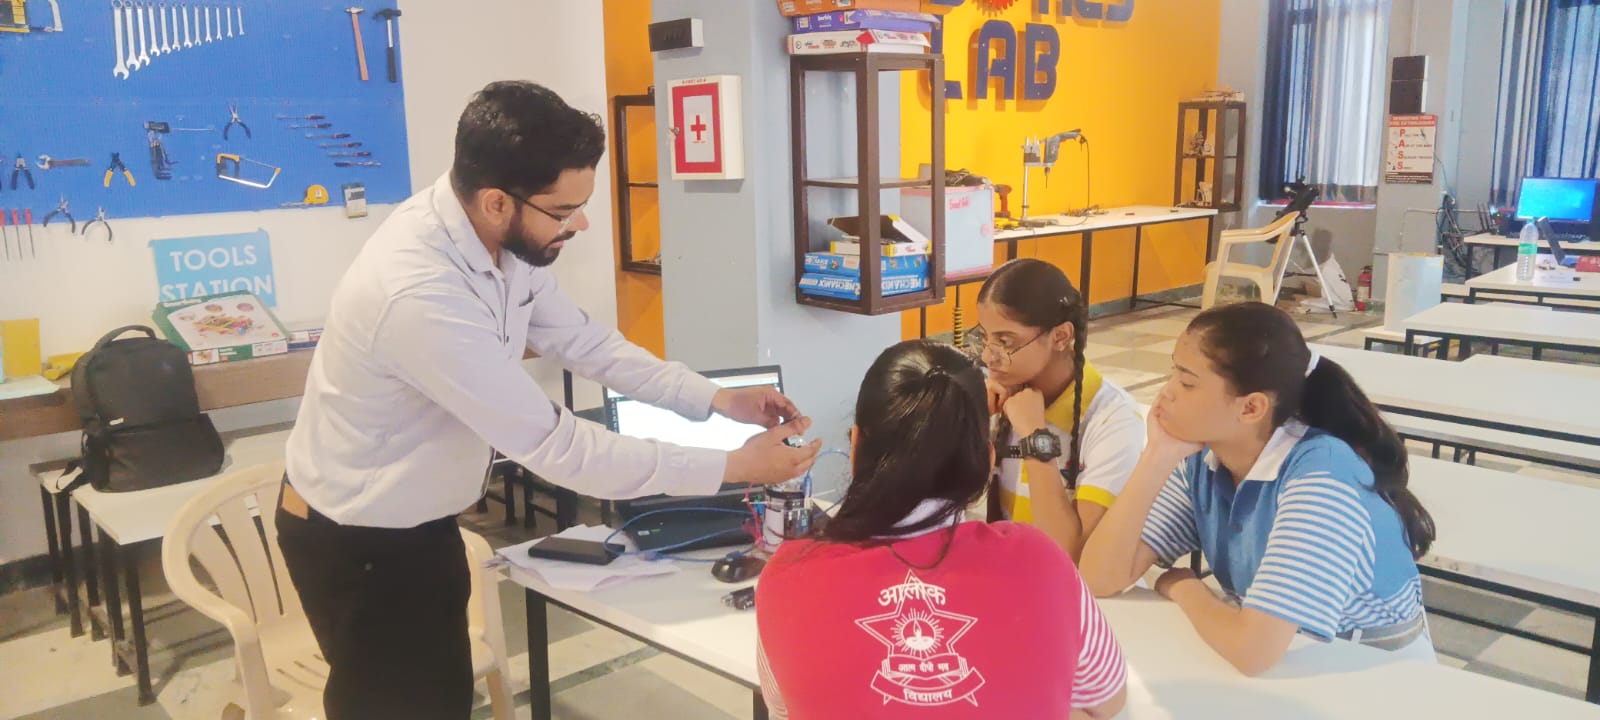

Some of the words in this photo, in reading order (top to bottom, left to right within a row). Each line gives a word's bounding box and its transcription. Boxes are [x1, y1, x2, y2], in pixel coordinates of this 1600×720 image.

[930, 15, 1060, 100] LAB
[169, 245, 257, 273] TOOLS
[160, 274, 273, 302] STATION
[878, 575, 946, 606] आलोक
[903, 687, 953, 703] विद्यालय
